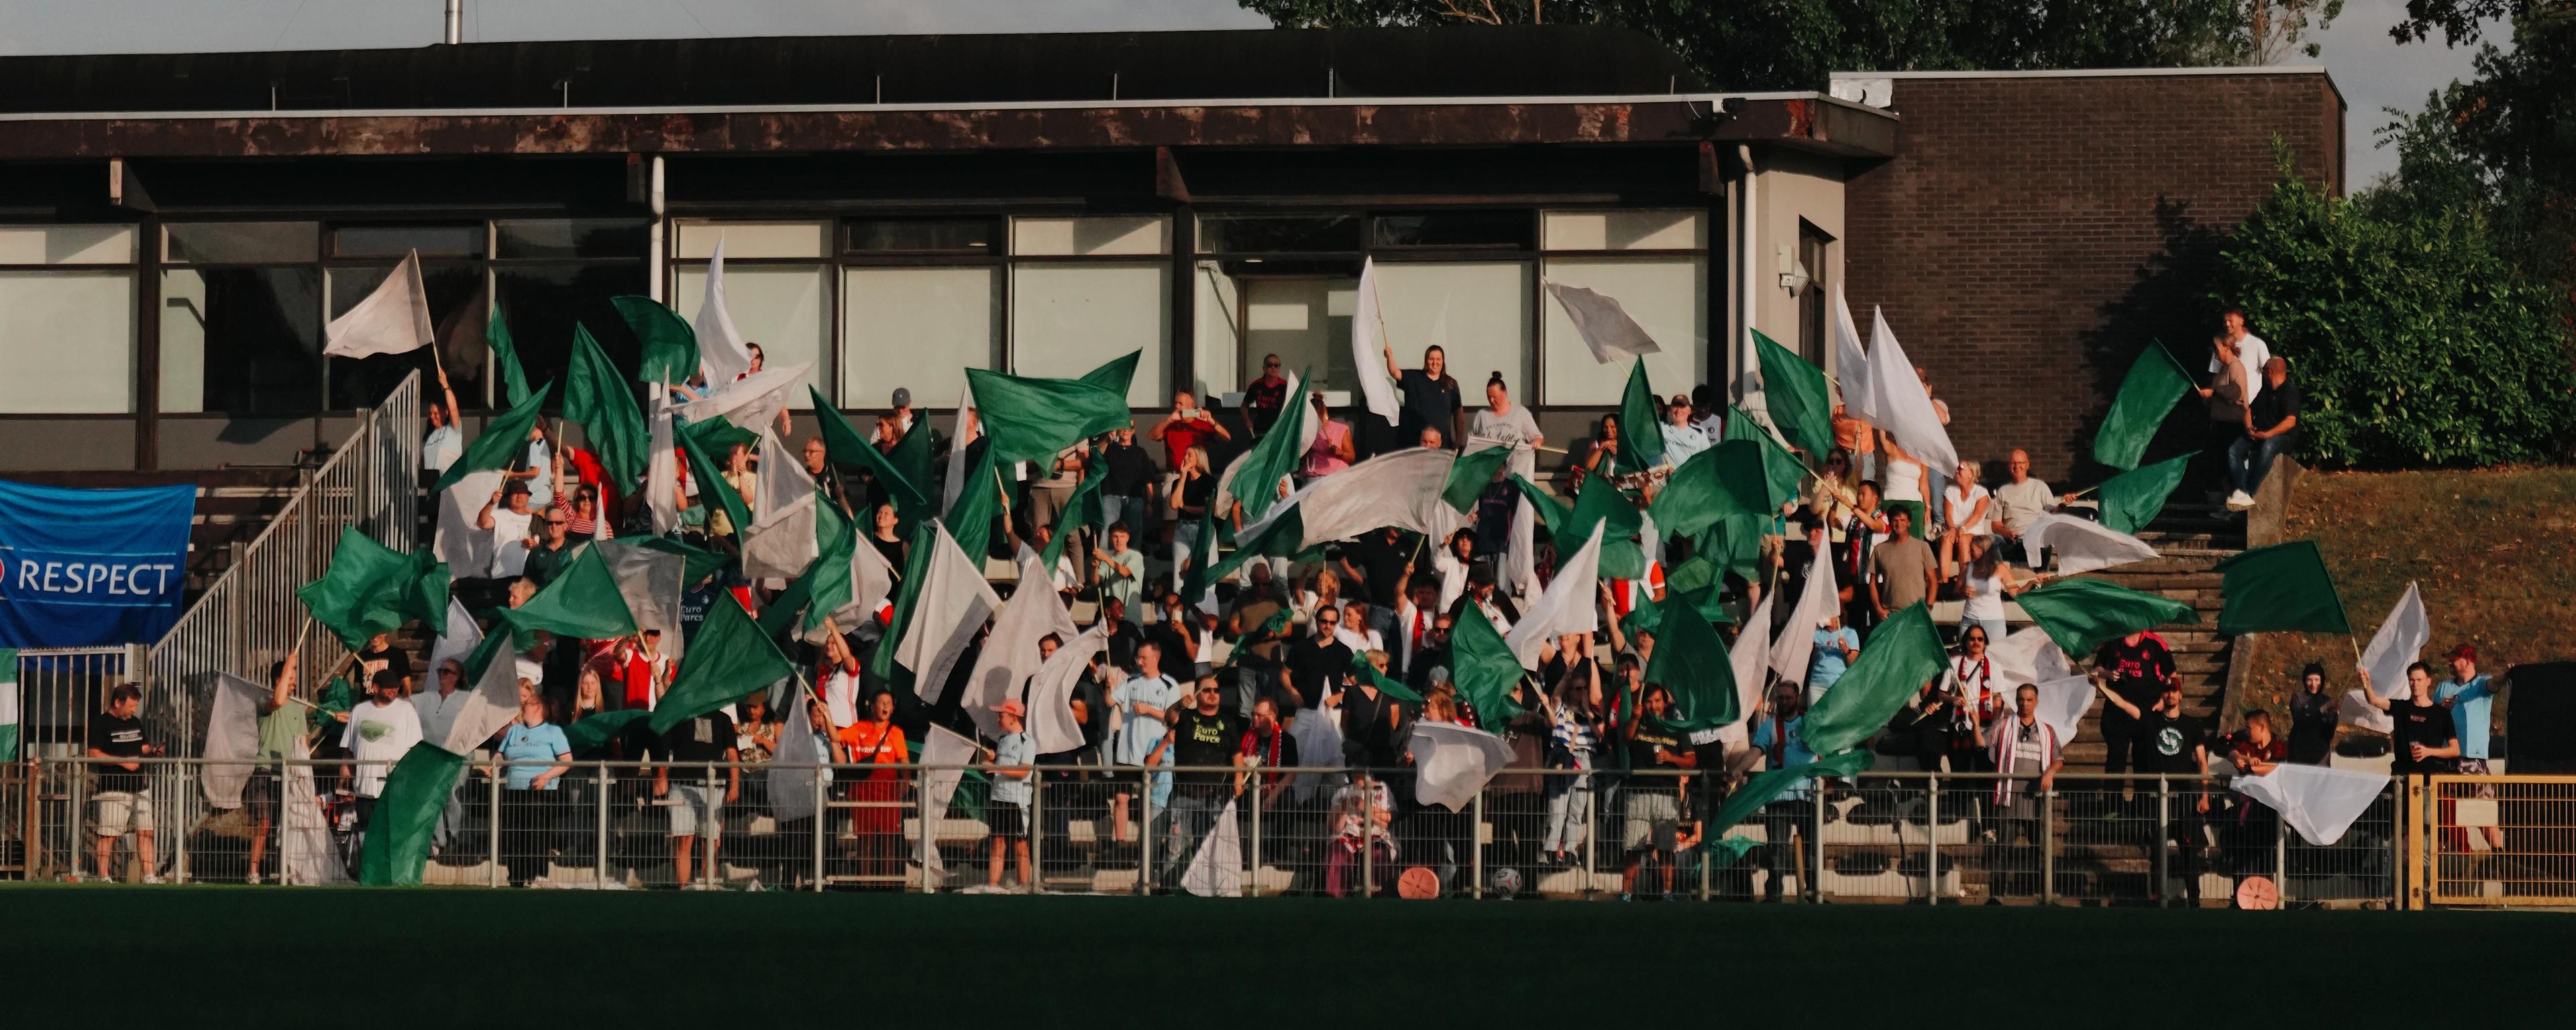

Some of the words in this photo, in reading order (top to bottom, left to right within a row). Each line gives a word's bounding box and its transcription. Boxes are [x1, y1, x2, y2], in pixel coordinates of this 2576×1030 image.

[18, 559, 175, 595] RESPECT
[680, 606, 702, 614] Euro
[680, 614, 704, 622] Parcs
[1195, 724, 1218, 736] Euro
[1193, 732, 1221, 744] Parcs
